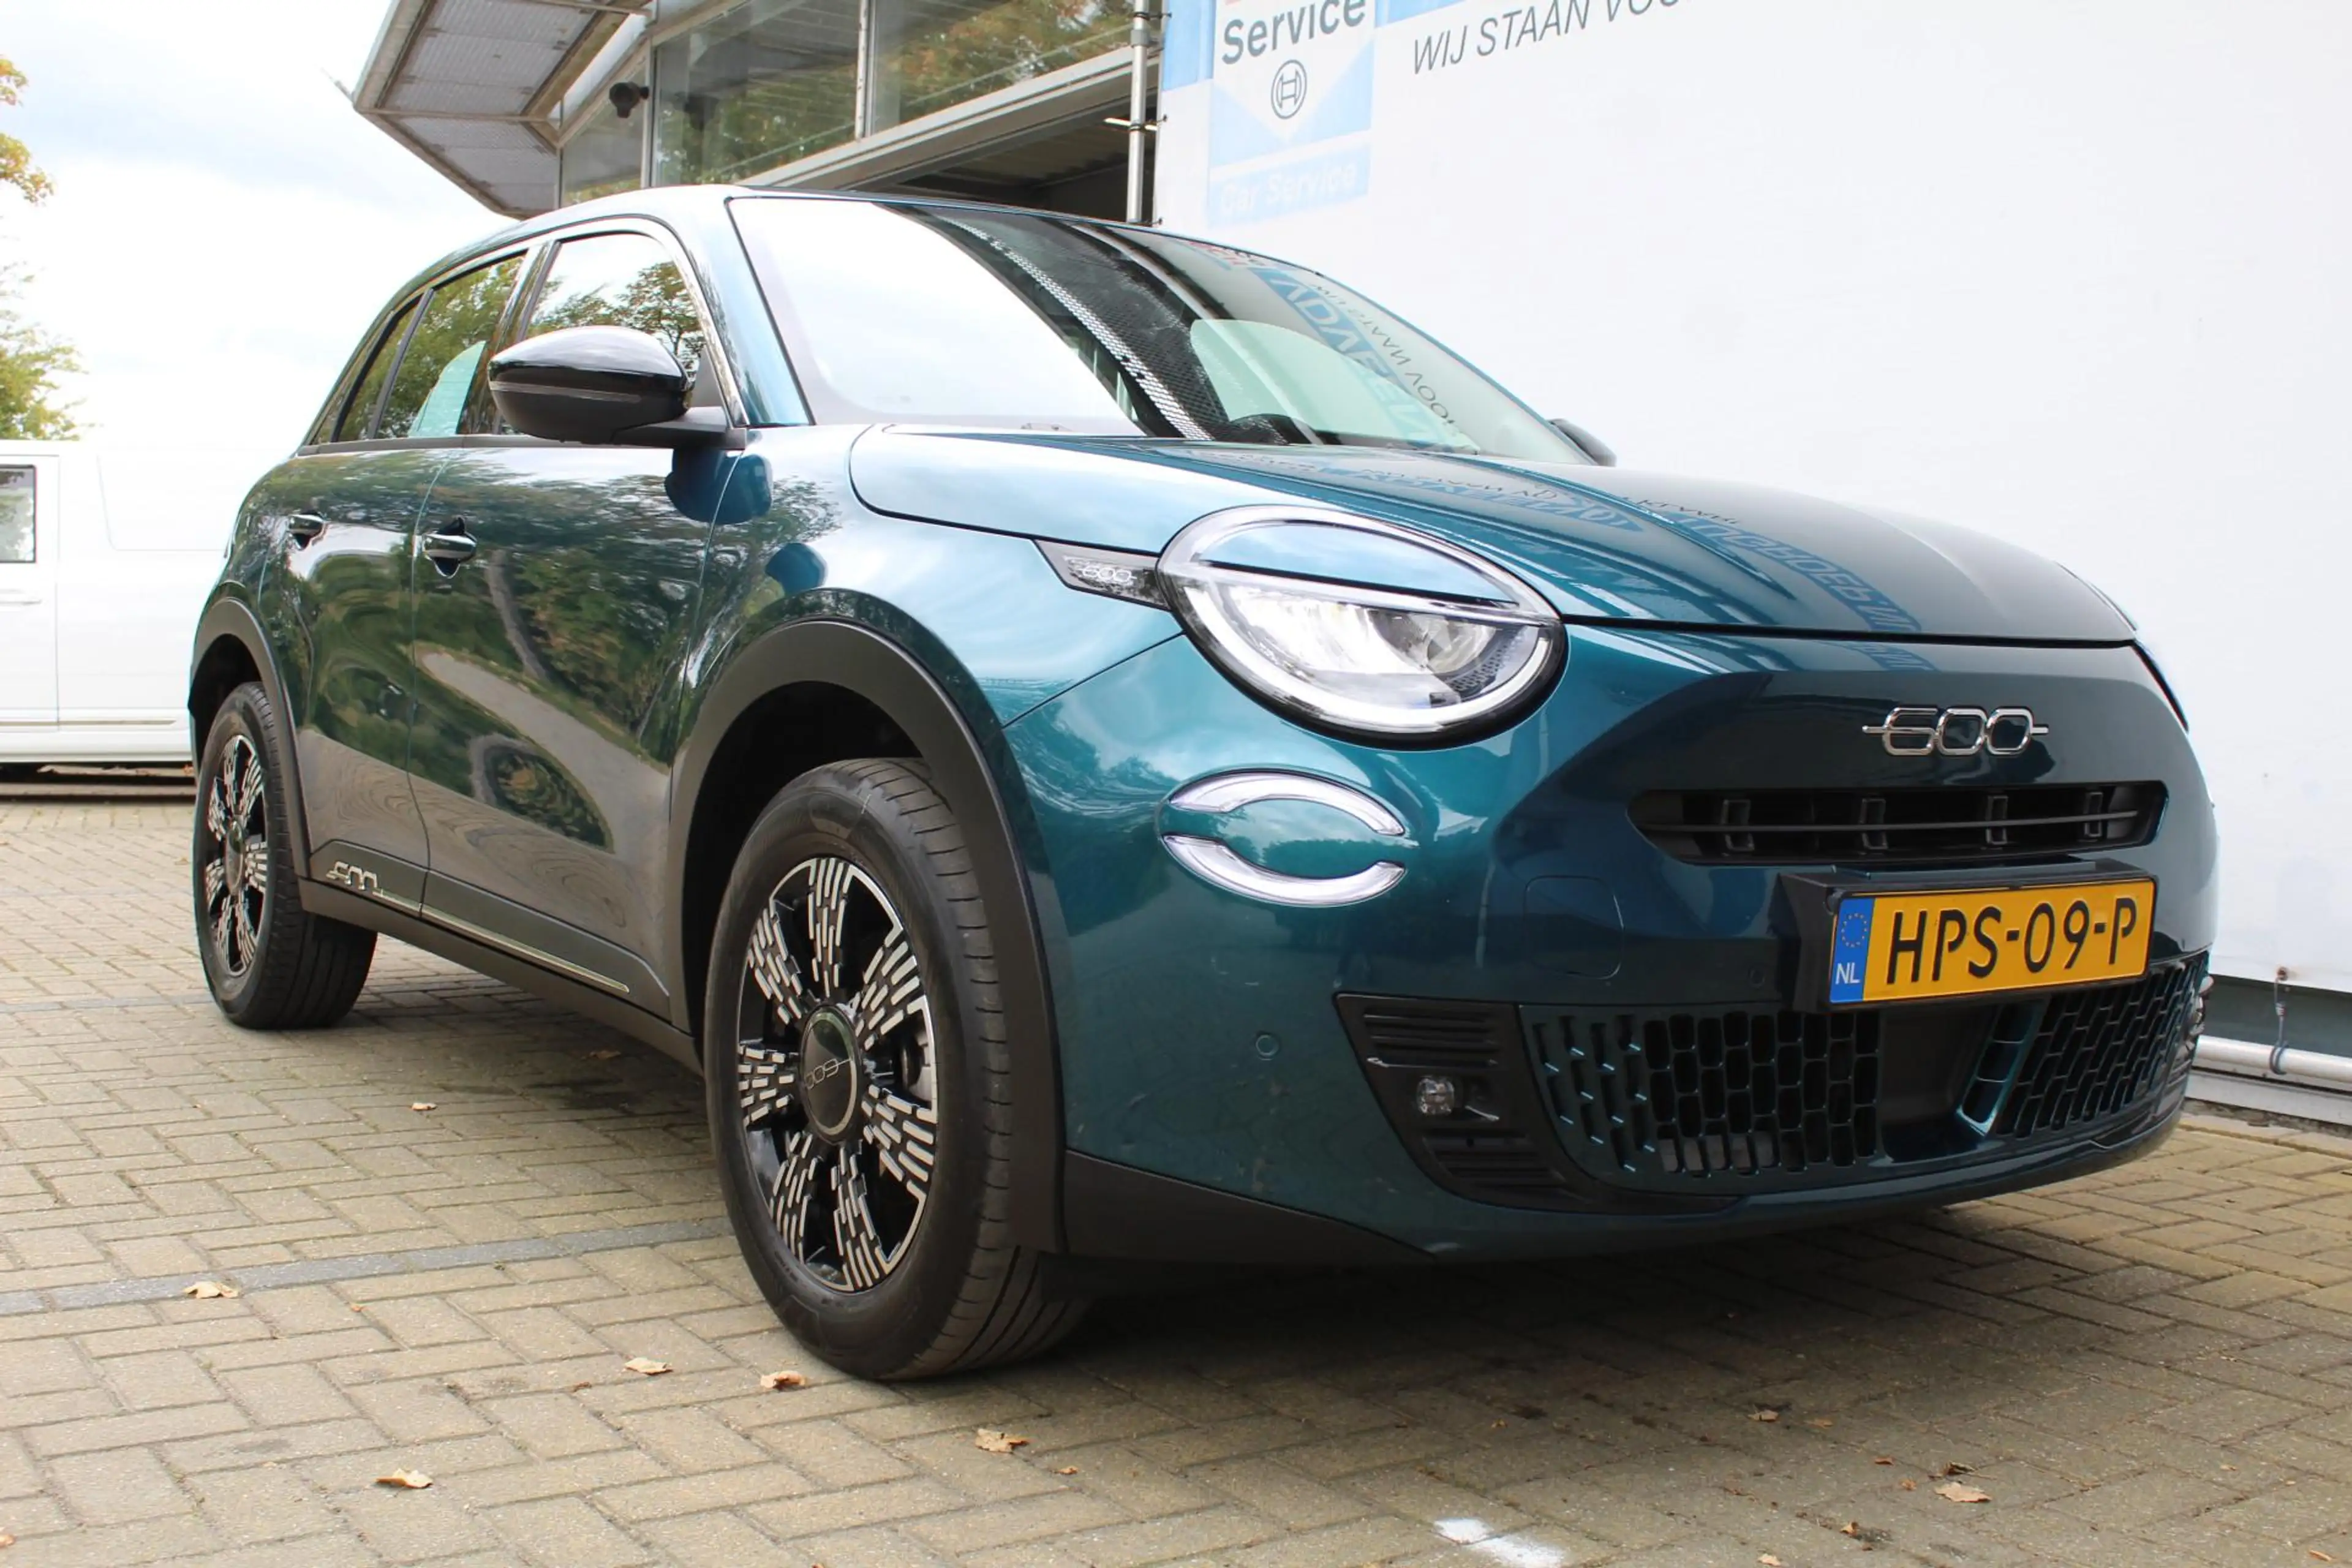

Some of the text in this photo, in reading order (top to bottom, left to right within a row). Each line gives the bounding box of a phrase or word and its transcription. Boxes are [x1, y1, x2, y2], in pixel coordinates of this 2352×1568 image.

[1222, 0, 1365, 65] Service
[1414, 24, 1468, 74] WIJ
[1477, 0, 1591, 56] STAAN
[1861, 707, 2049, 756] 600
[1835, 962, 1860, 984] NL
[1886, 897, 2137, 984] HPS-09-P
